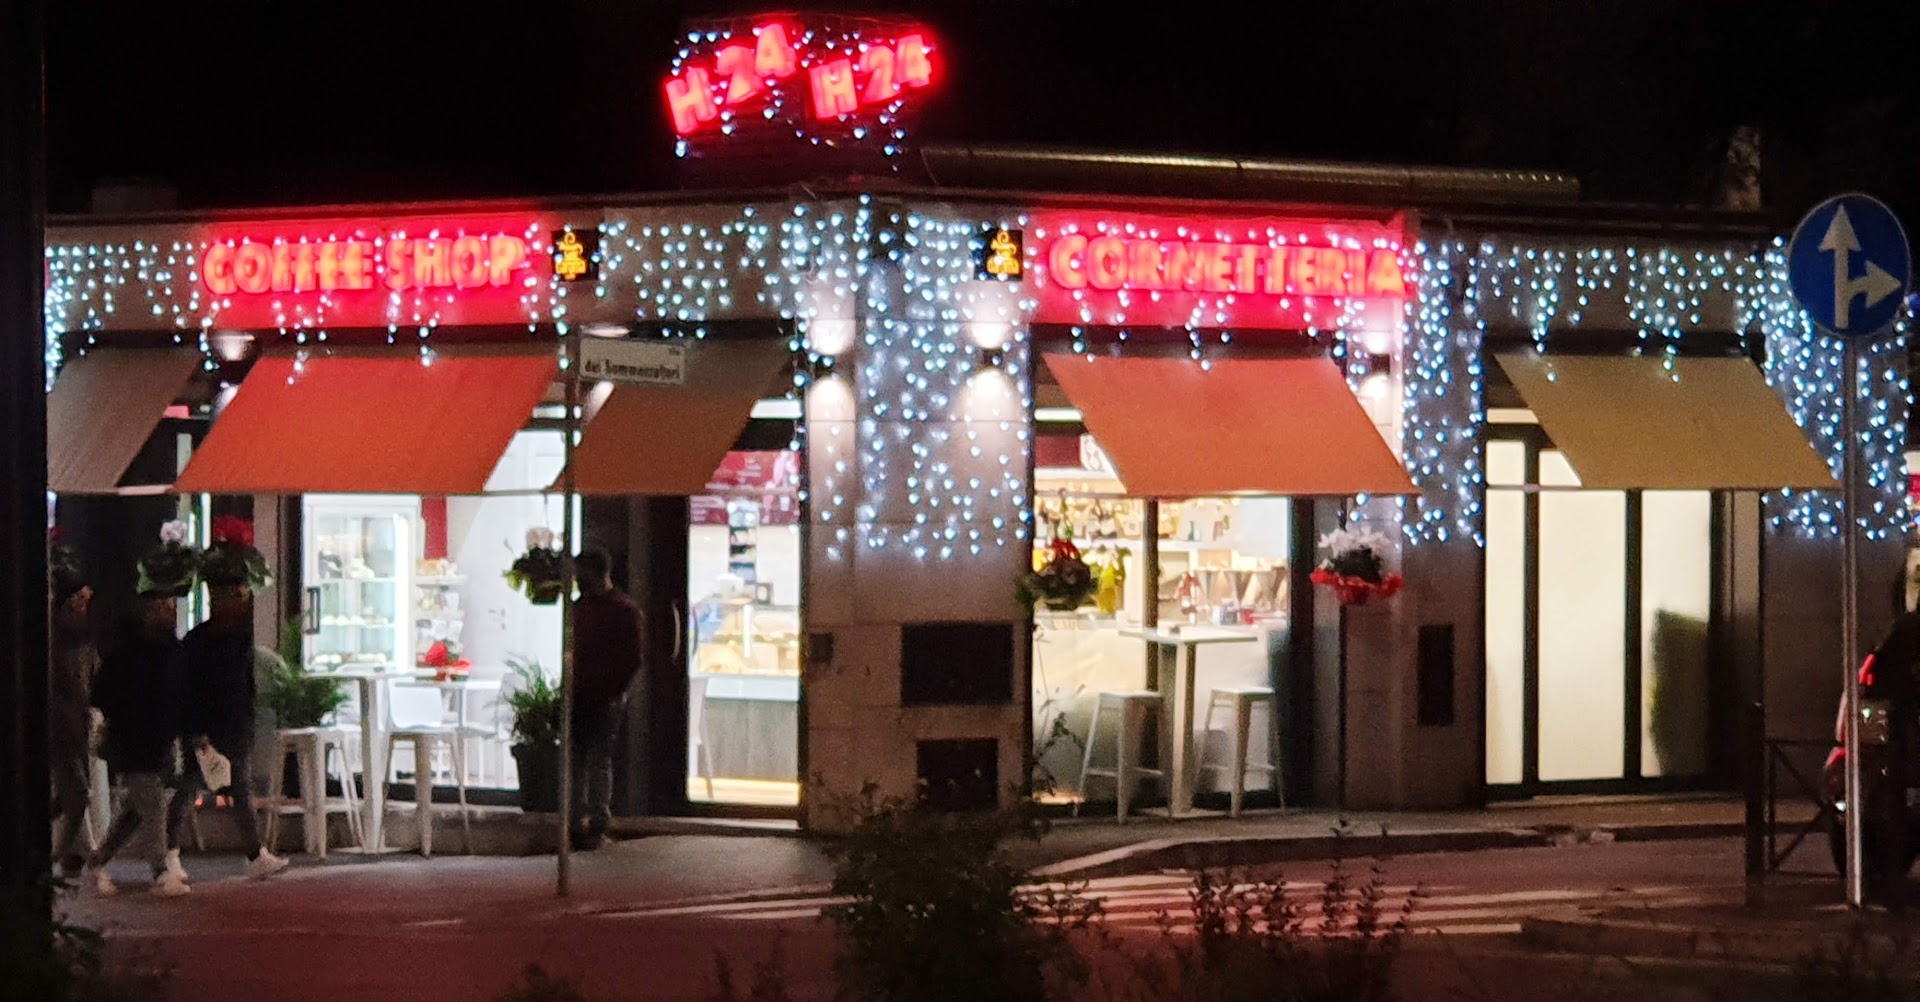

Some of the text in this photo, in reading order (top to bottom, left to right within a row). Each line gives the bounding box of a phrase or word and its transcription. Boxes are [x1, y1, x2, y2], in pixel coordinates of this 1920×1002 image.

[203, 233, 526, 295] COFFEE SHOP
[1049, 233, 1407, 297] CORNETTERIA
